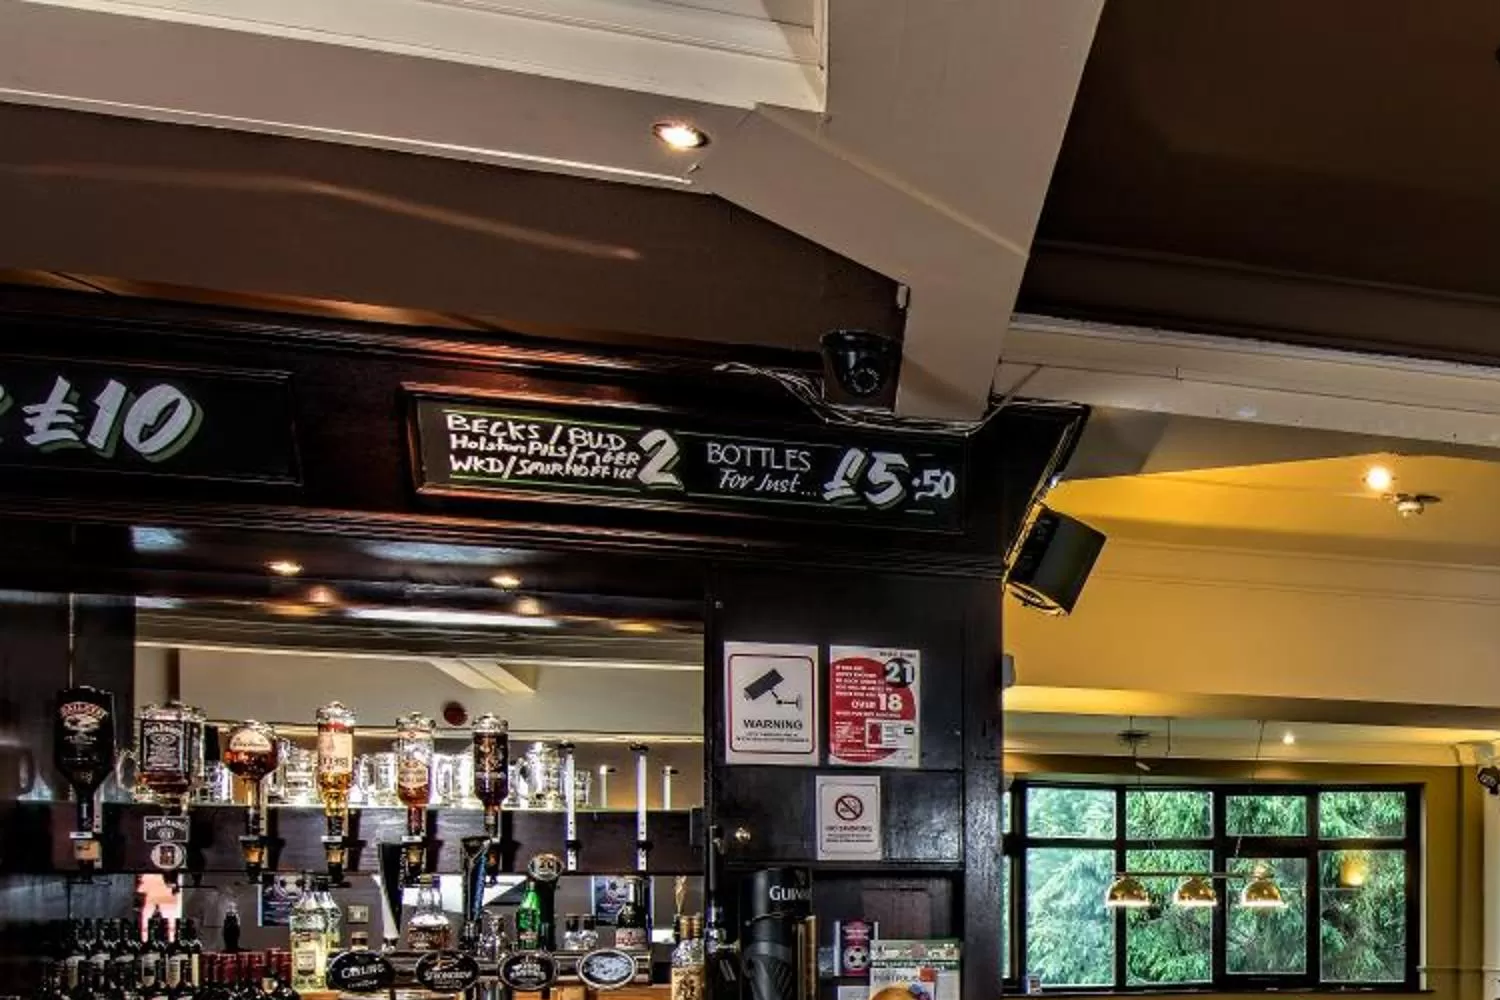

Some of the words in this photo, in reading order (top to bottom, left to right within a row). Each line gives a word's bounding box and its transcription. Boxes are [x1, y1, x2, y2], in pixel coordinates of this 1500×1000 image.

[22, 375, 200, 460] £10
[447, 413, 541, 441] BECKS
[567, 427, 627, 450] BUD
[637, 429, 686, 491] 2
[707, 442, 811, 472] BOTTLES
[718, 468, 754, 489] For
[885, 661, 914, 684] 21
[878, 693, 903, 712] 18
[743, 719, 803, 730] WARNING
